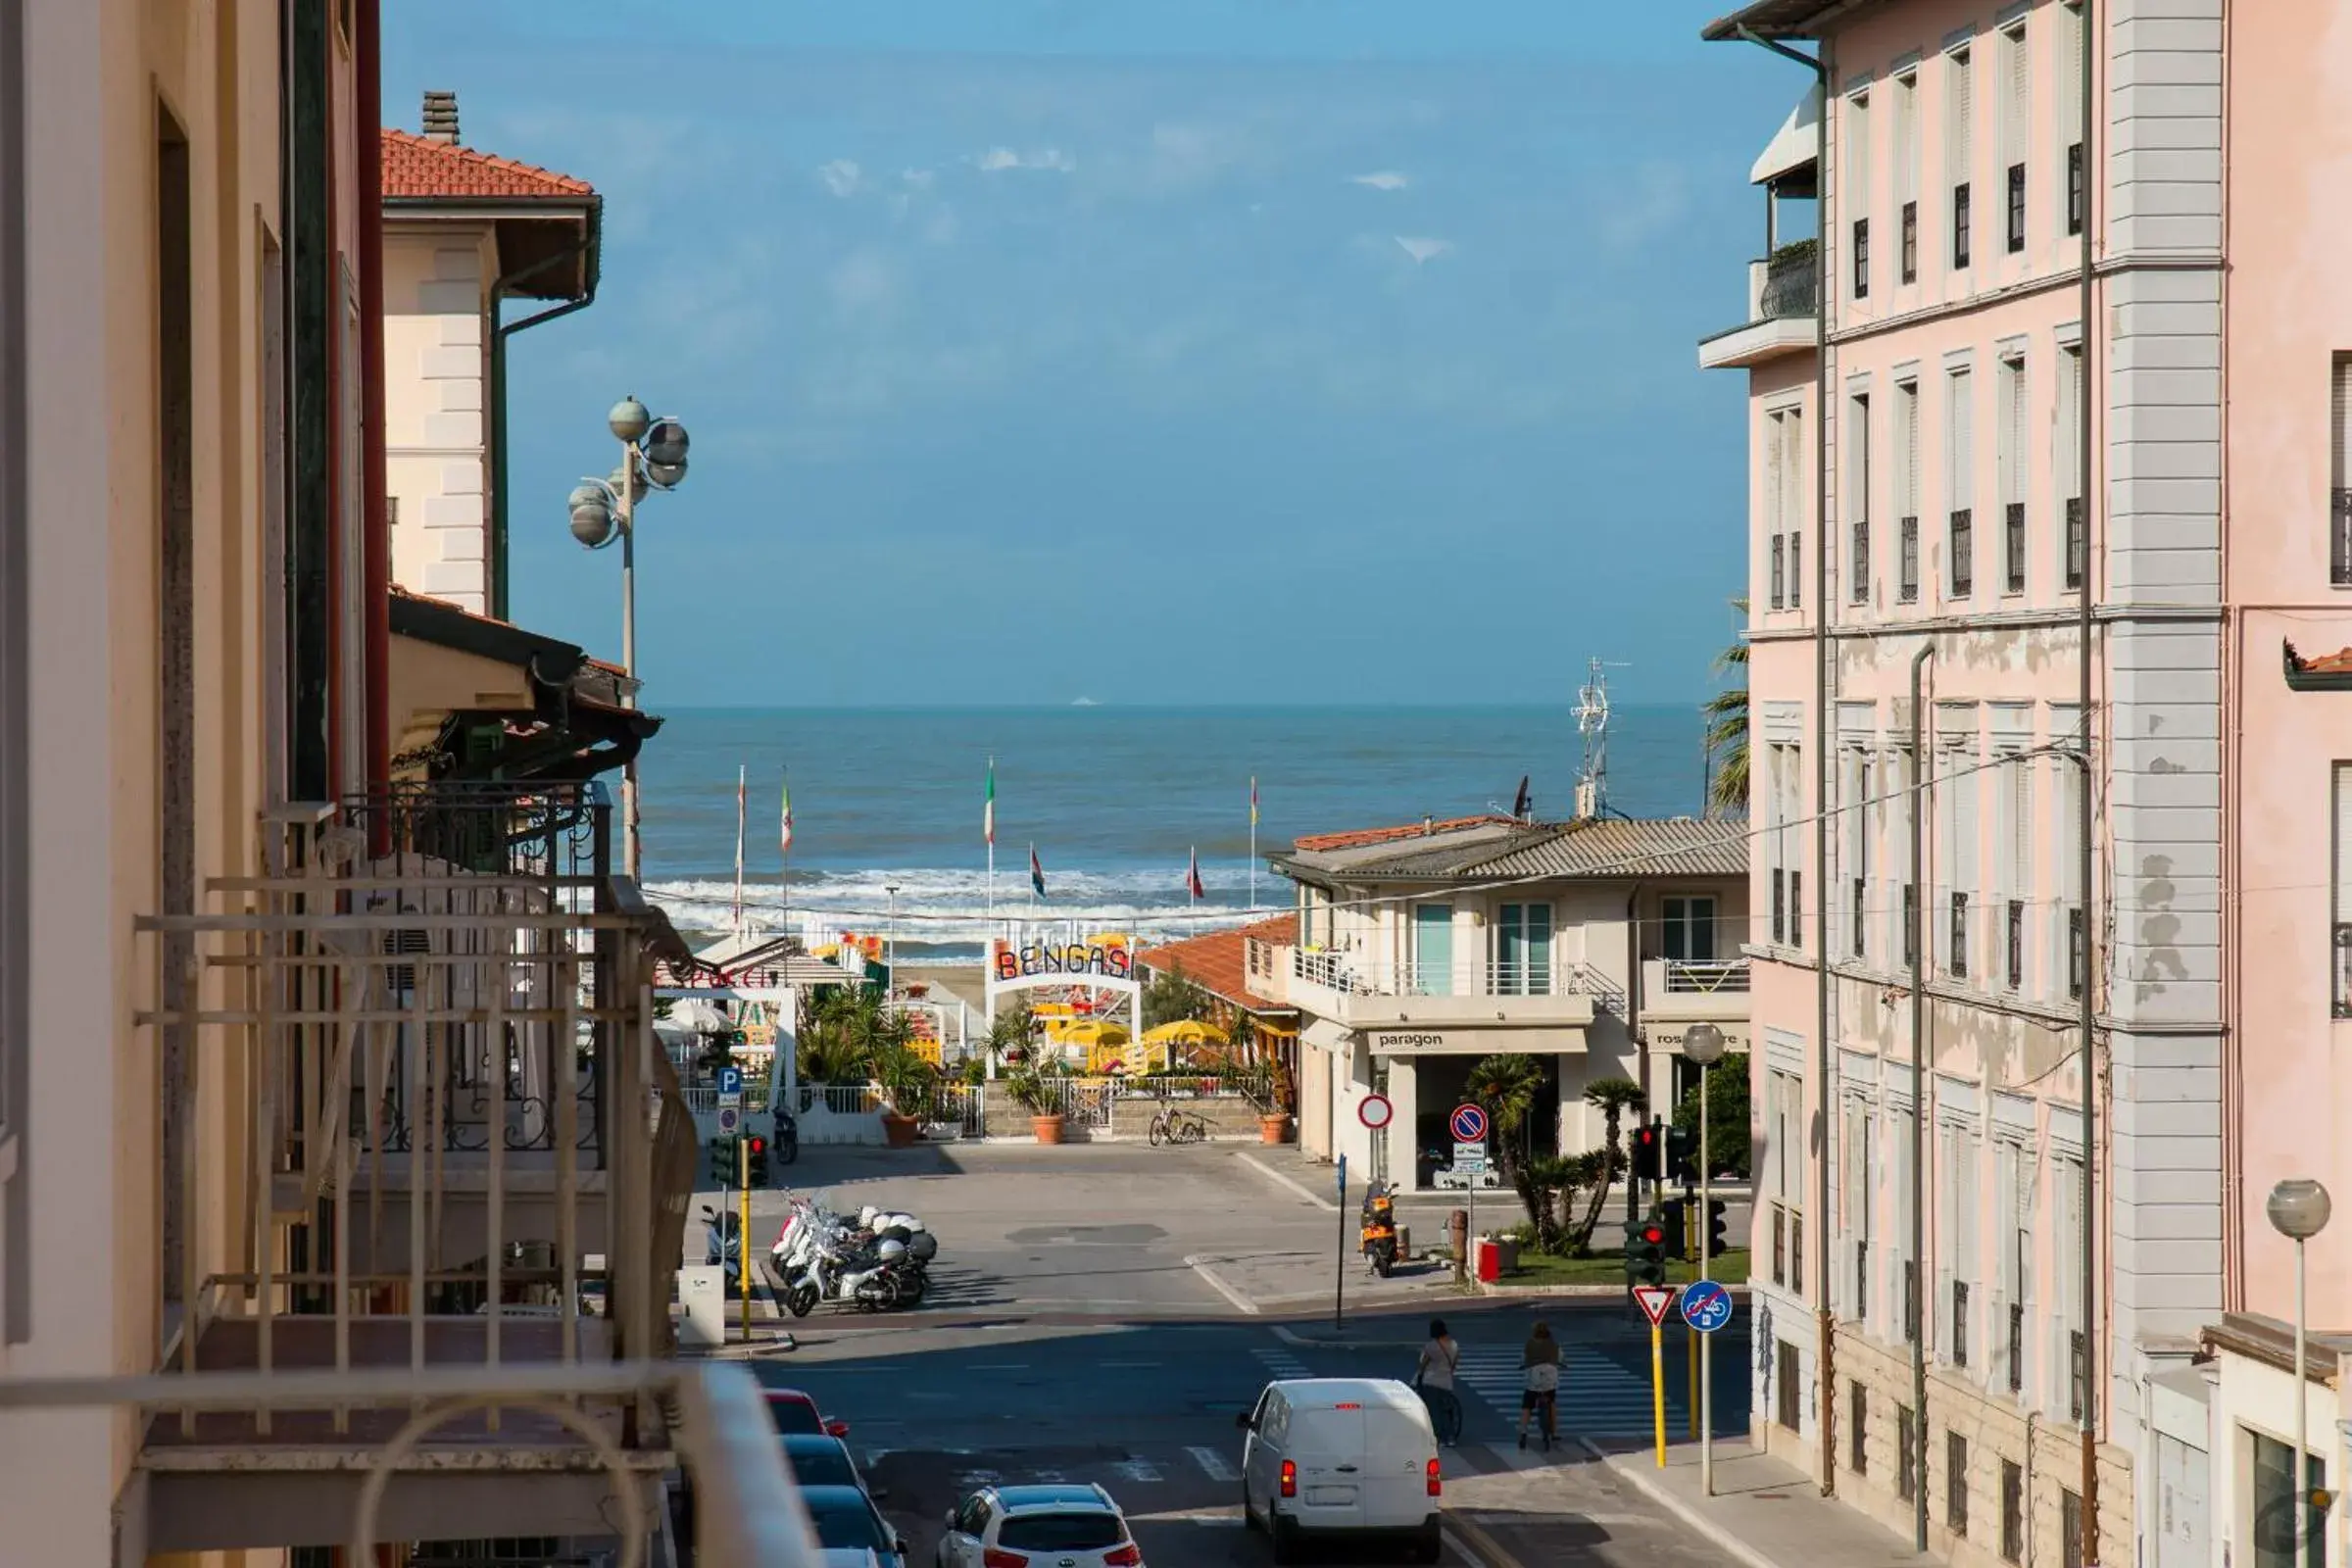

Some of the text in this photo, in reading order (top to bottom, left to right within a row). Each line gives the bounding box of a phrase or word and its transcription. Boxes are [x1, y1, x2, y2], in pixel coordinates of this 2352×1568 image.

[999, 944, 1134, 980] BENGASI
[1380, 1035, 1443, 1047] paragon
[1657, 1035, 1683, 1044] ros
[723, 1070, 738, 1092] P
